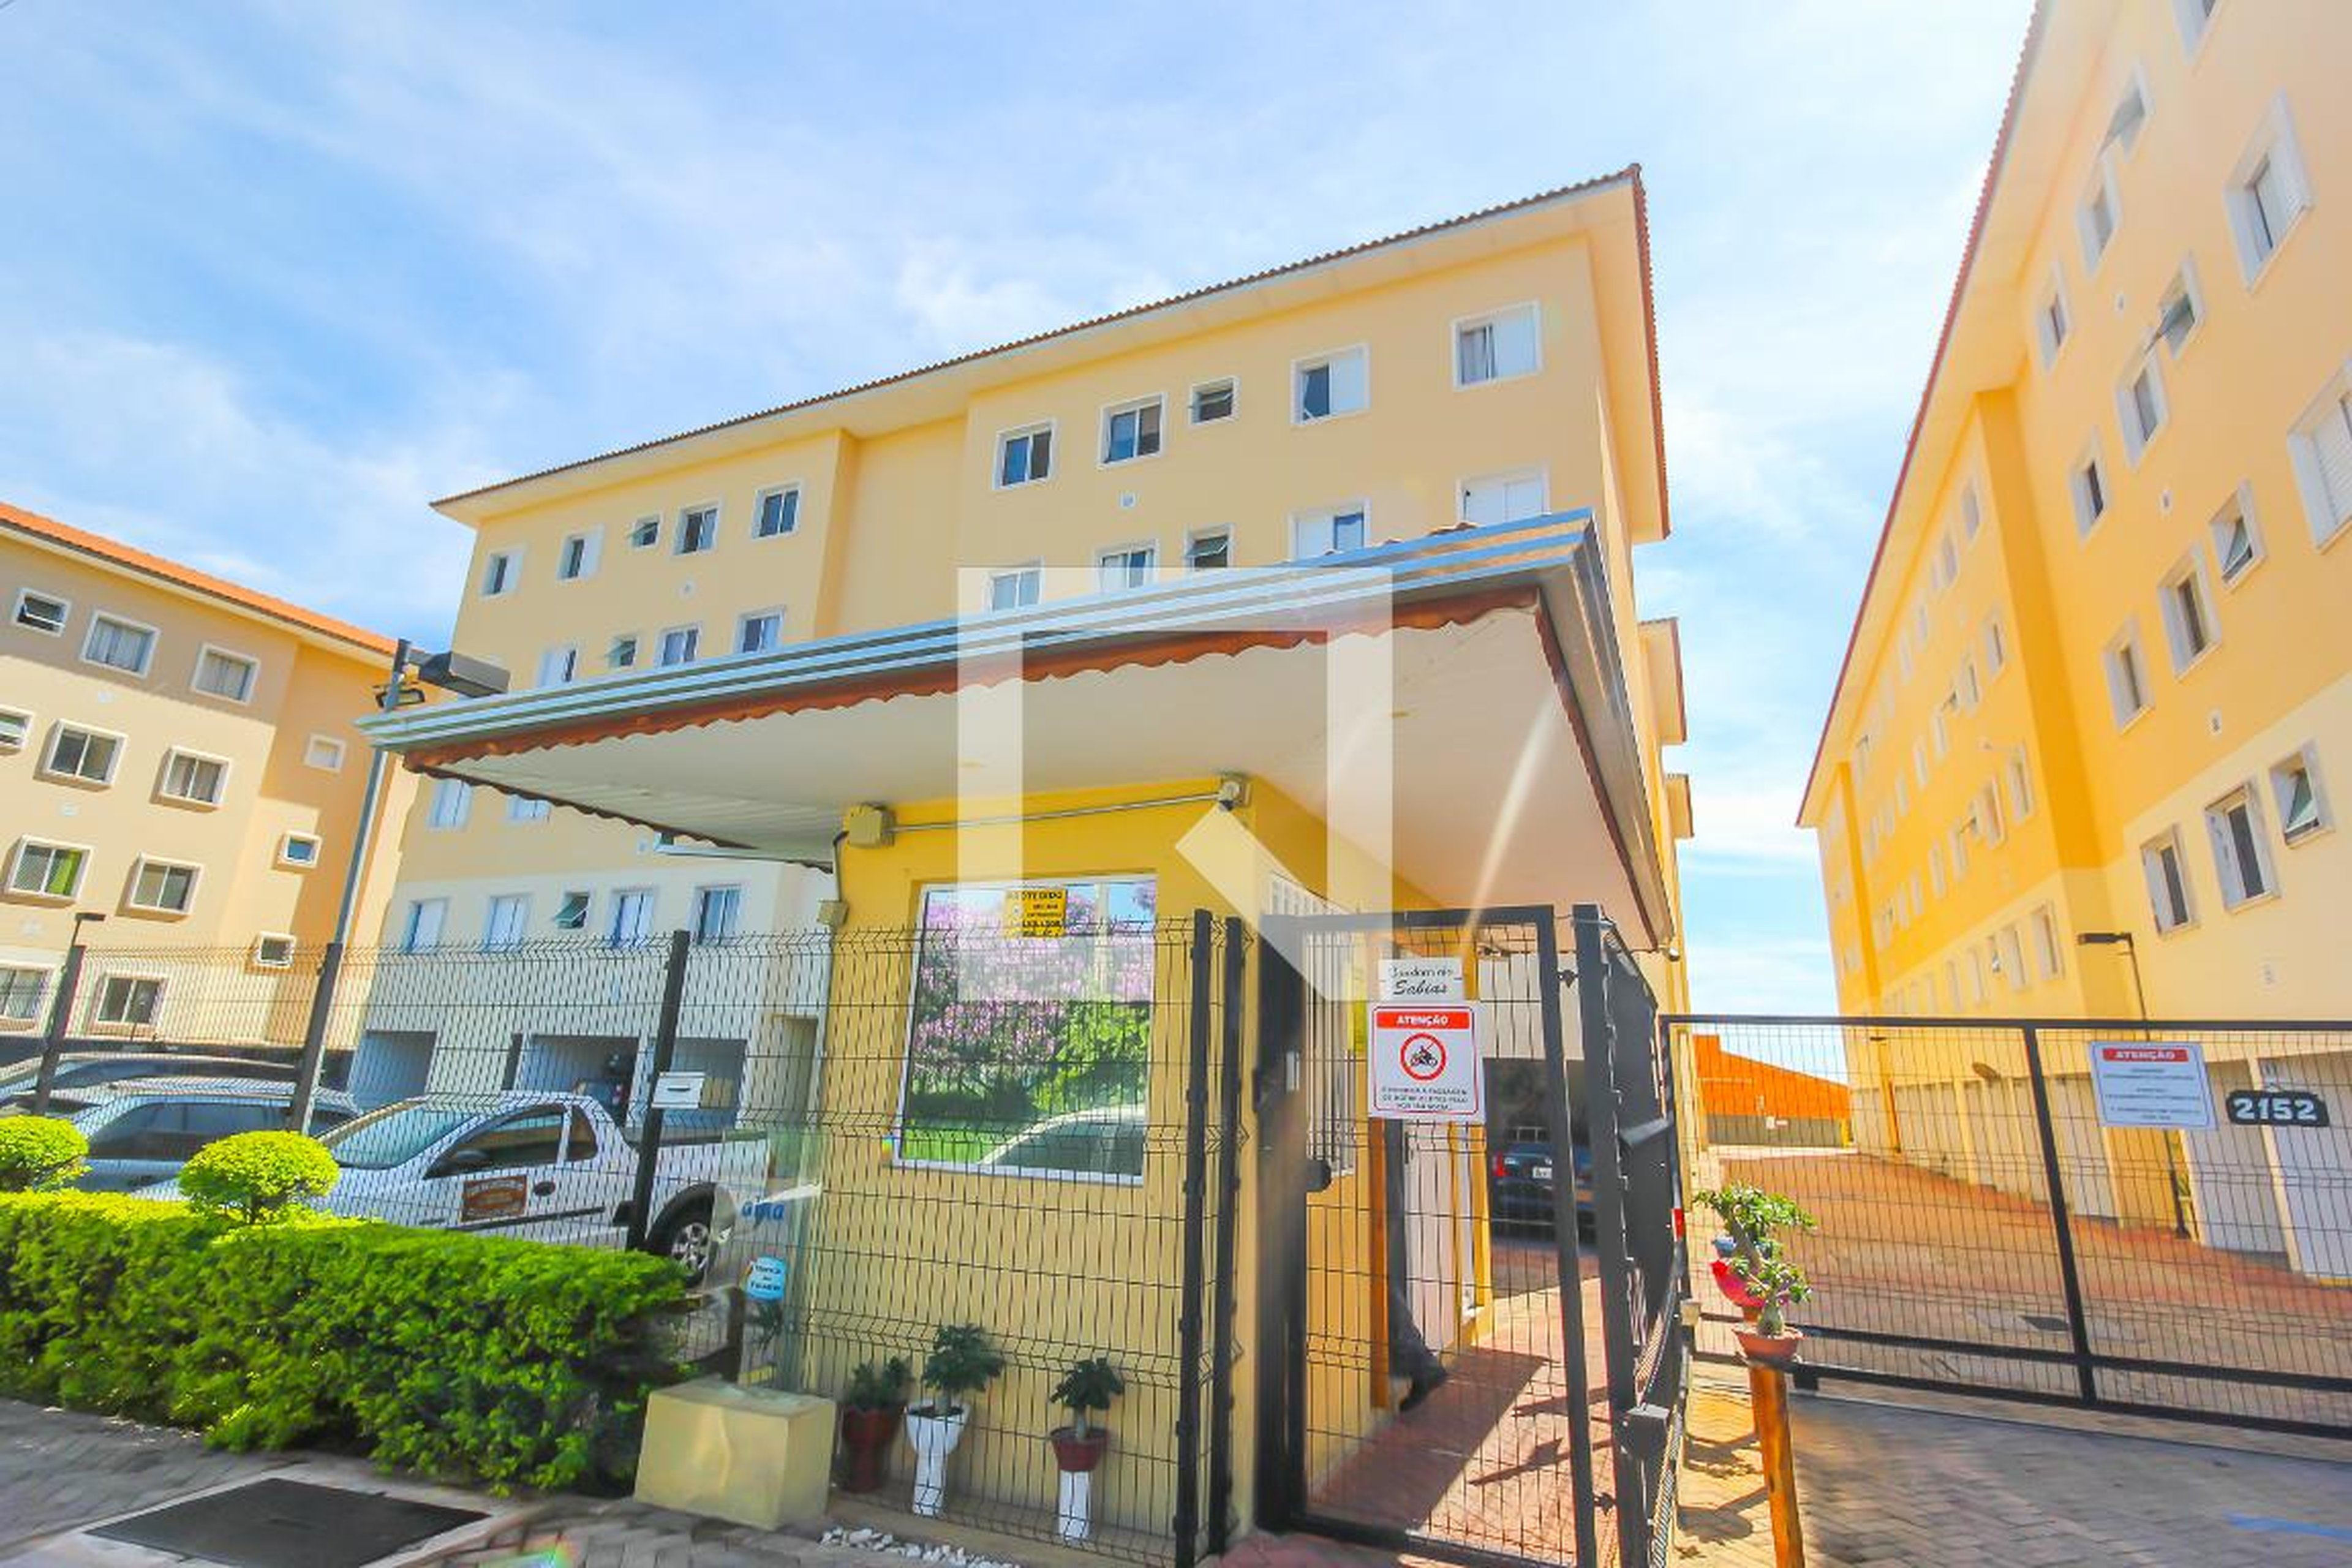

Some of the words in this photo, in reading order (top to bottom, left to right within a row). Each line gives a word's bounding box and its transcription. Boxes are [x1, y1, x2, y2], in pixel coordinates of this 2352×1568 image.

[1396, 1014, 1449, 1026] ATENÇÃO
[2114, 1049, 2176, 1060] ATENÇÃO
[2233, 1098, 2318, 1121] 2152
